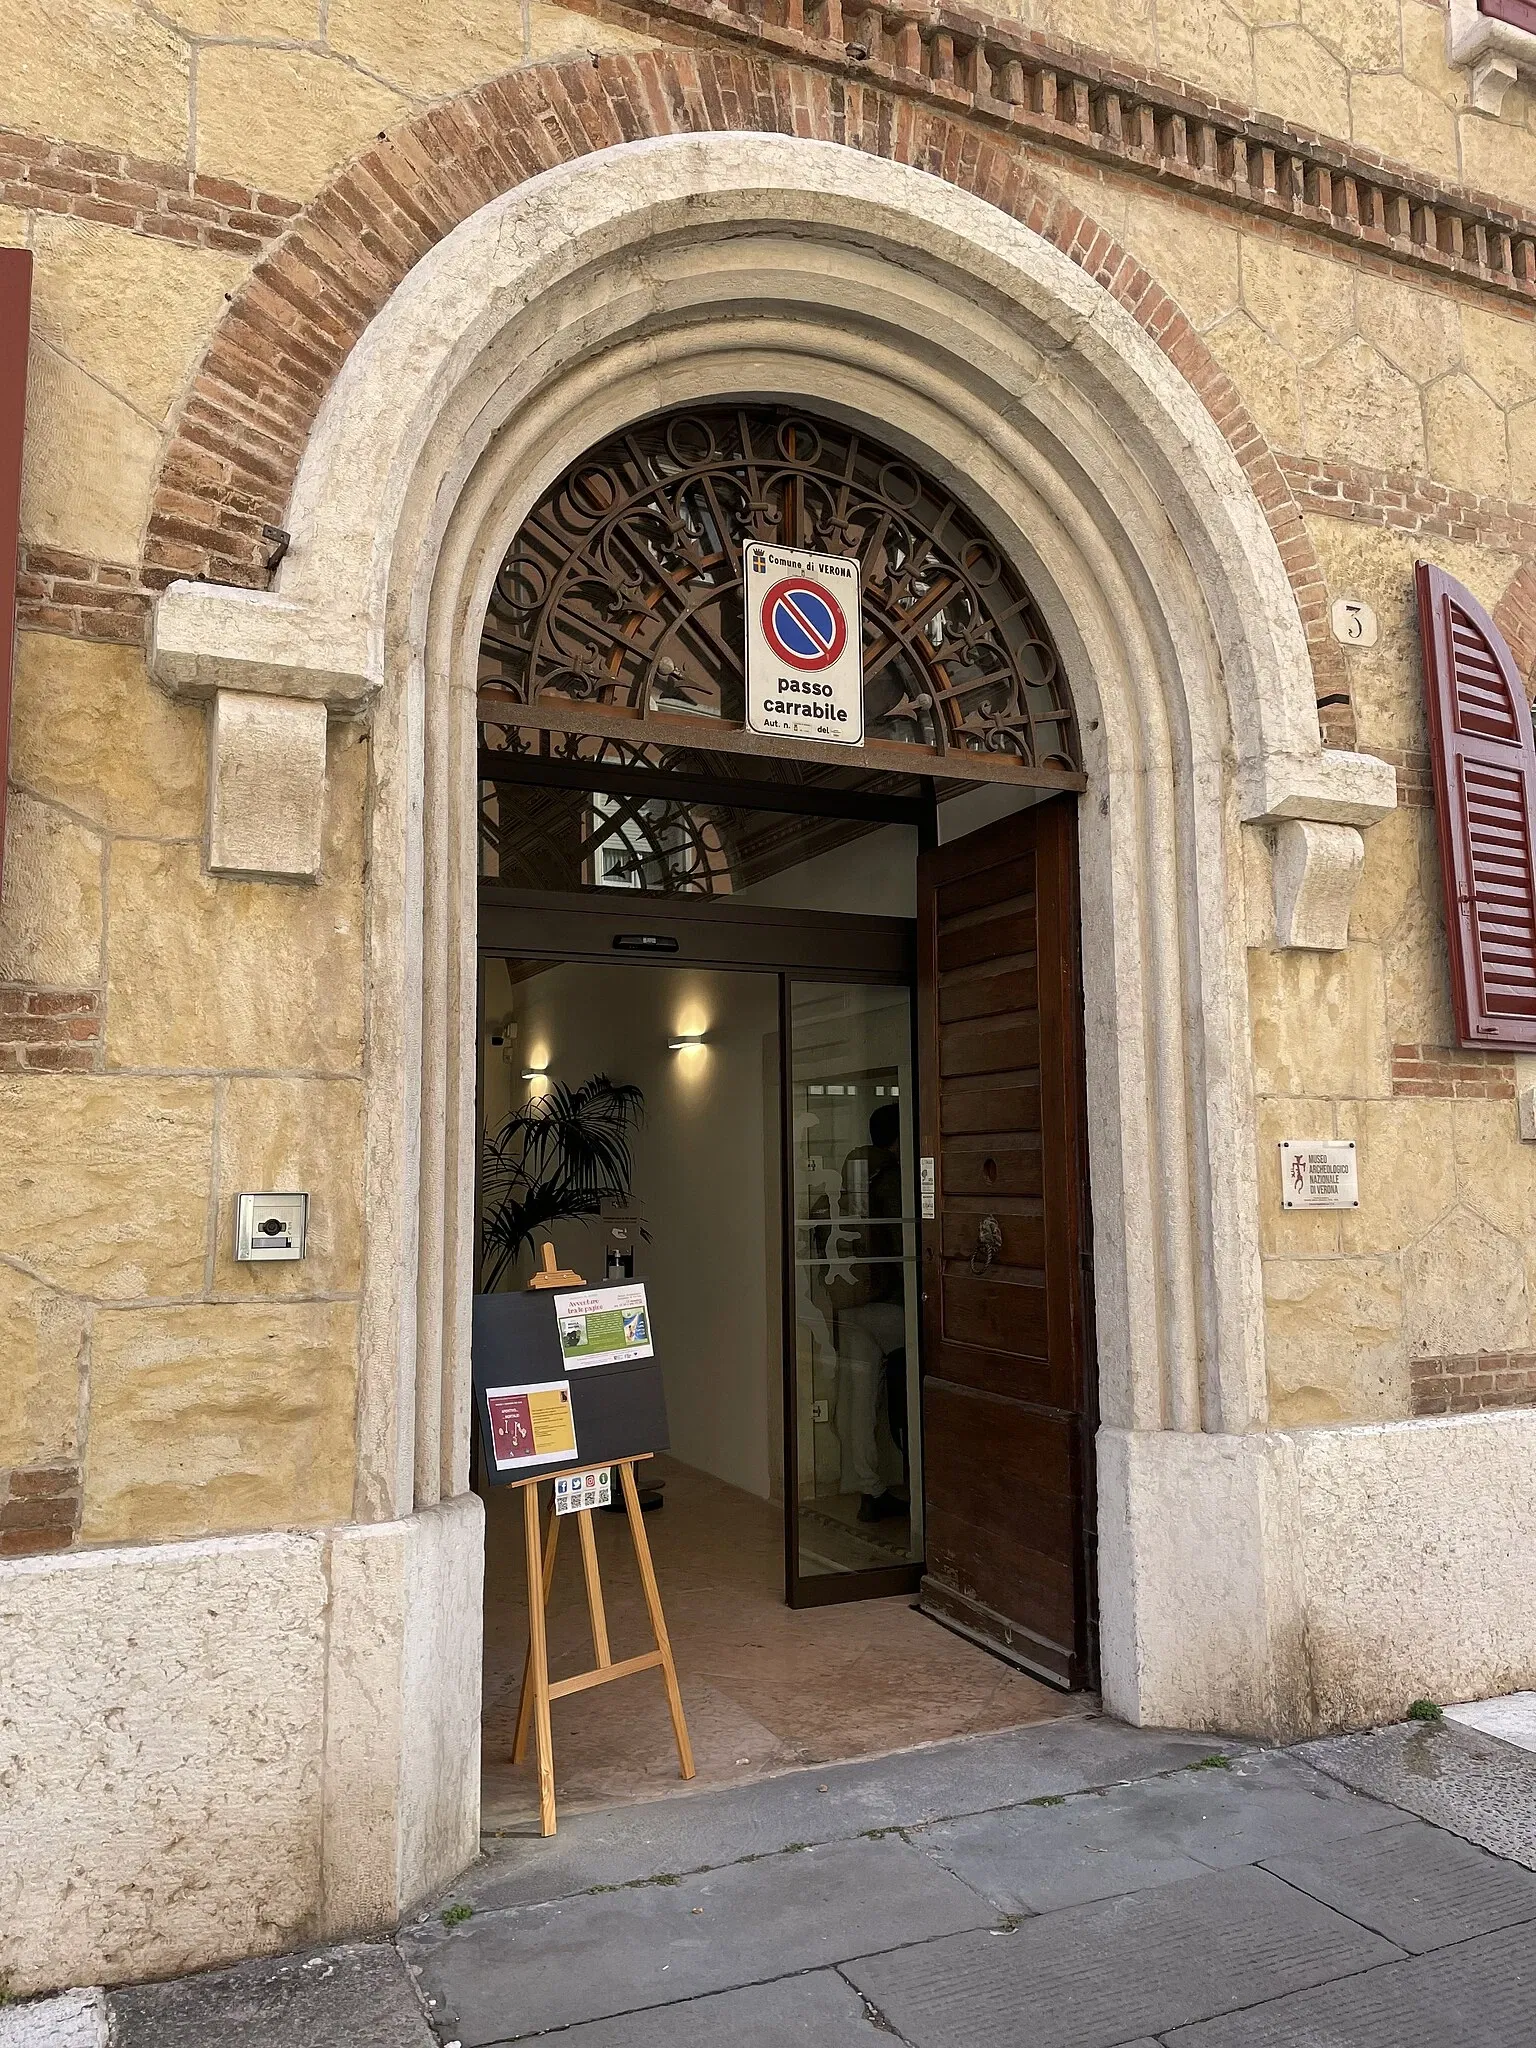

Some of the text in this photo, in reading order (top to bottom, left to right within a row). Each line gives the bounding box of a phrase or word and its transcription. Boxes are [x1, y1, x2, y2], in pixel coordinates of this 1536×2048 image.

[768, 554, 851, 578] Comune di VERONA
[1345, 605, 1362, 638] 3
[778, 677, 833, 697] passo
[763, 699, 848, 722] carrabile
[764, 718, 781, 728] Aut.
[817, 726, 830, 734] del
[1308, 1154, 1327, 1164] MUSEO
[1309, 1164, 1348, 1174] ARCHEOLOGICO
[1310, 1174, 1340, 1184] NAZIONALE
[1310, 1185, 1339, 1194] DI VERONA
